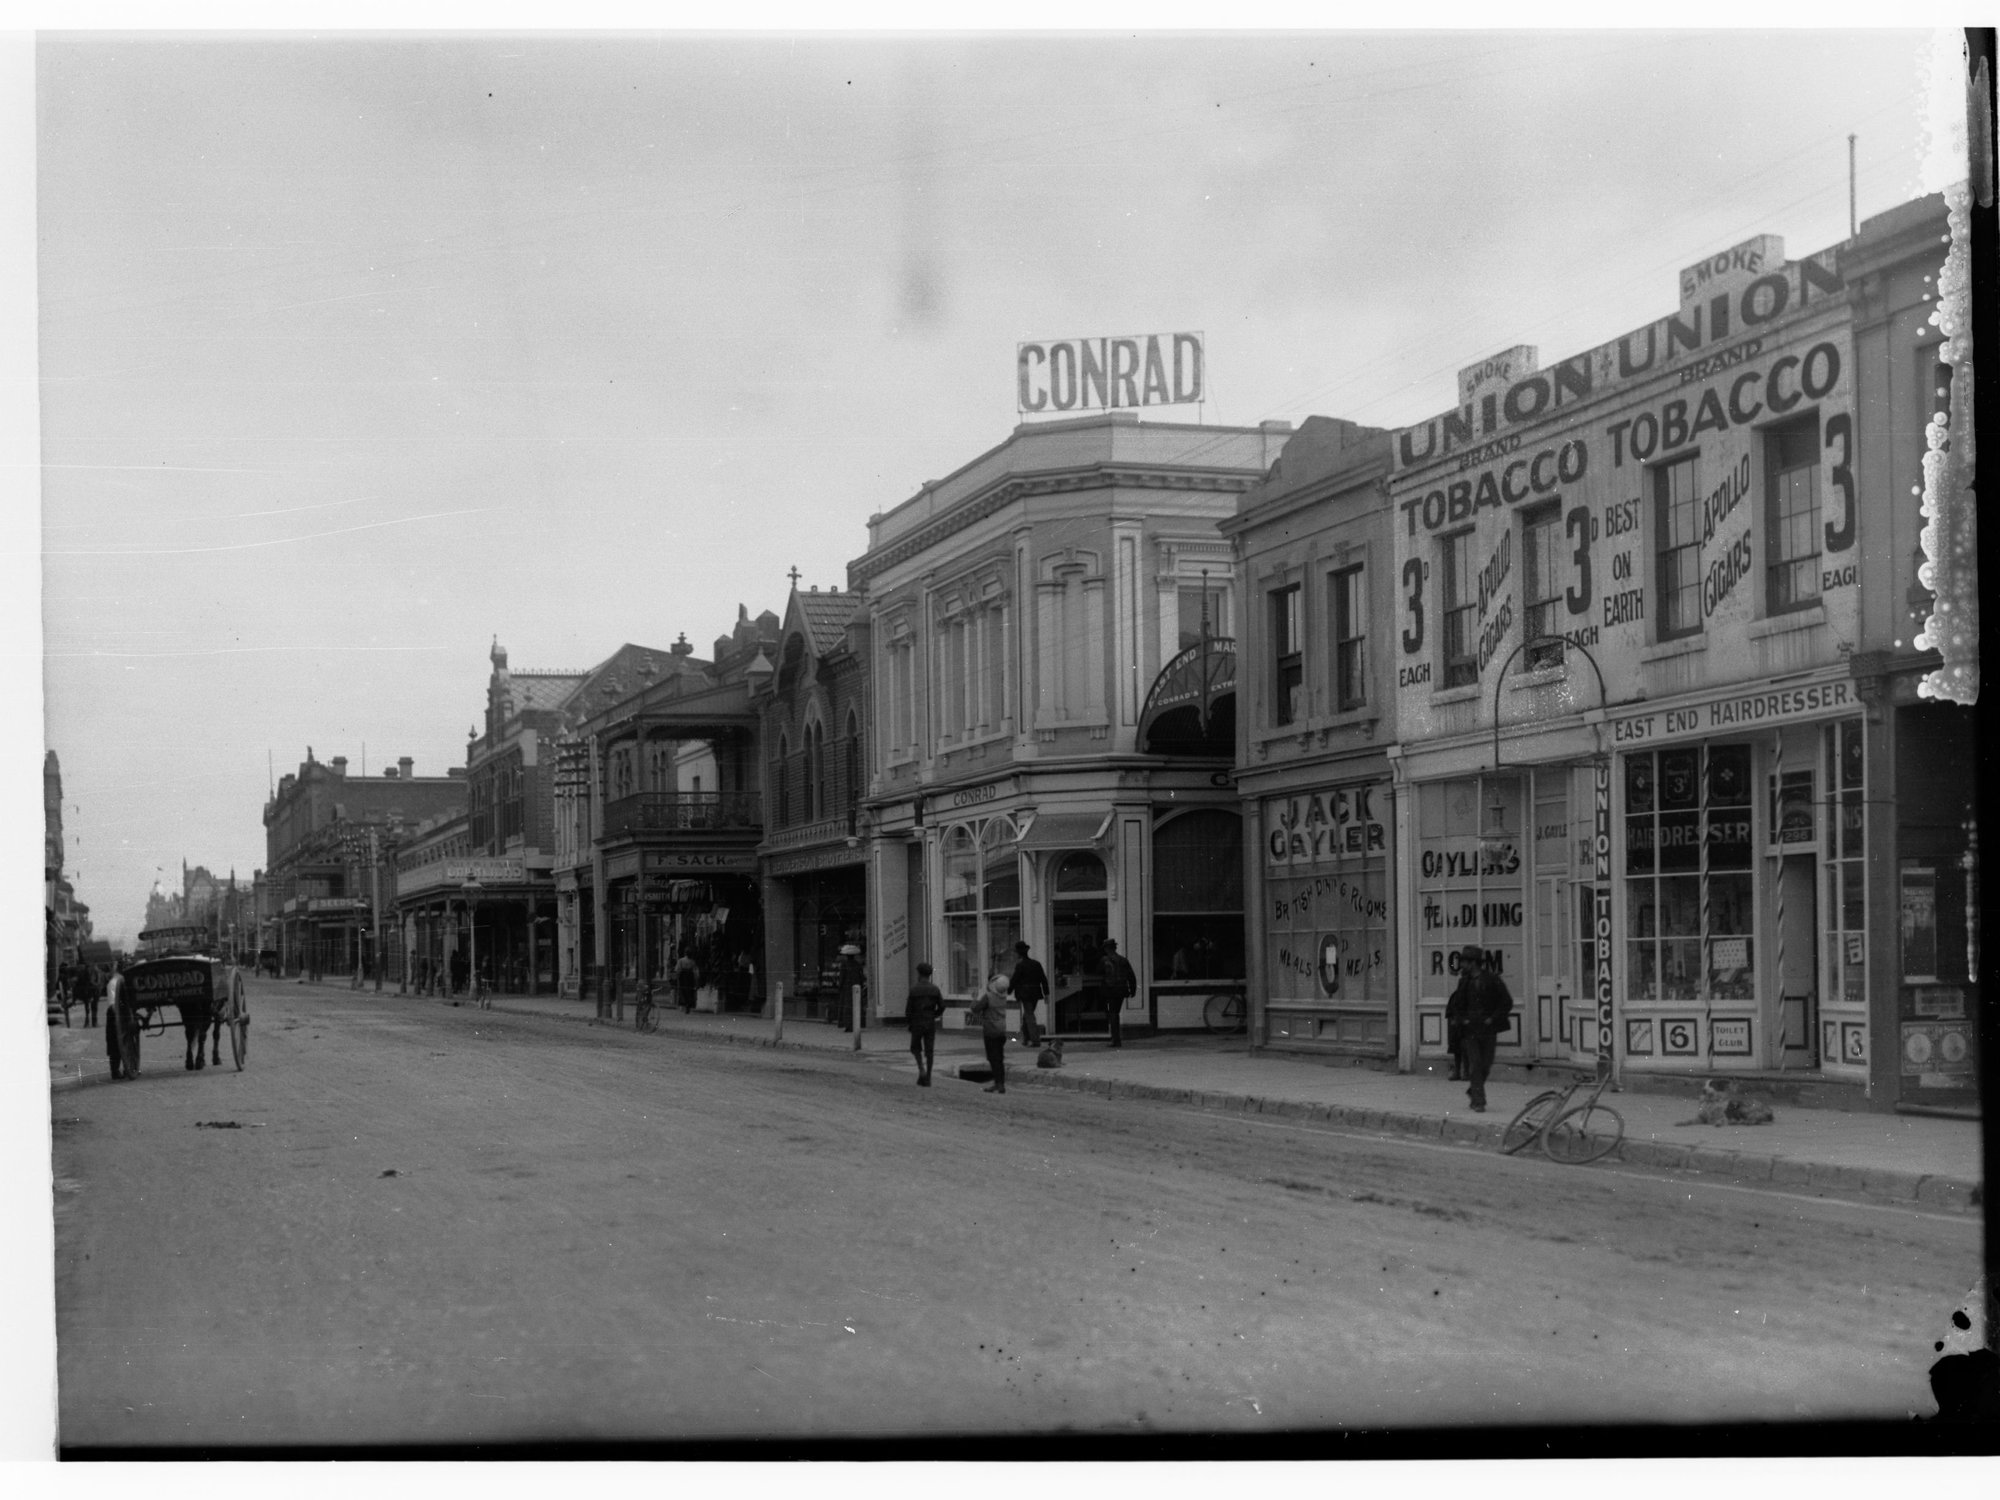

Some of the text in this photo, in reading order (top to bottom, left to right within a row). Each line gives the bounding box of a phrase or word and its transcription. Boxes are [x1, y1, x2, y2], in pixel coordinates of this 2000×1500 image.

[1682, 252, 1763, 300] SMOKE
[1618, 248, 1845, 378] UNION
[1019, 333, 1202, 410] CONRAD
[1466, 362, 1511, 398] SMOKE
[1681, 338, 1763, 386] BRAND
[1400, 352, 1593, 467] UNION
[1607, 342, 1841, 469] TOBACCO
[1459, 434, 1522, 471] BRAND
[1400, 439, 1589, 537] TOBACCO
[1702, 452, 1751, 550] APOLLO
[1605, 498, 1641, 539] BEST
[1478, 528, 1511, 627] APOLLO
[1612, 550, 1632, 581] ON
[1603, 587, 1645, 628] EARTH
[1148, 667, 1171, 710] EAST
[1176, 648, 1197, 670] END
[1157, 690, 1199, 706] CONRAD'S
[1615, 683, 1856, 742] EAST END HAIRDRESSER.
[953, 785, 996, 806] CONRAD
[1279, 788, 1375, 831] JACK
[1597, 768, 1610, 875] UNION
[657, 855, 672, 866] F.
[677, 855, 726, 866] SACK
[1270, 823, 1386, 862] GAYLER
[1274, 884, 1313, 921] BRTISH
[1461, 902, 1523, 928] DINING
[132, 970, 205, 991] CONRAD
[1431, 949, 1505, 977] ROM
[1598, 896, 1613, 1047] TOBACCO
[1669, 1025, 1690, 1049] 6
[1715, 1026, 1744, 1035] TOILET
[1850, 1030, 1863, 1056] 3
